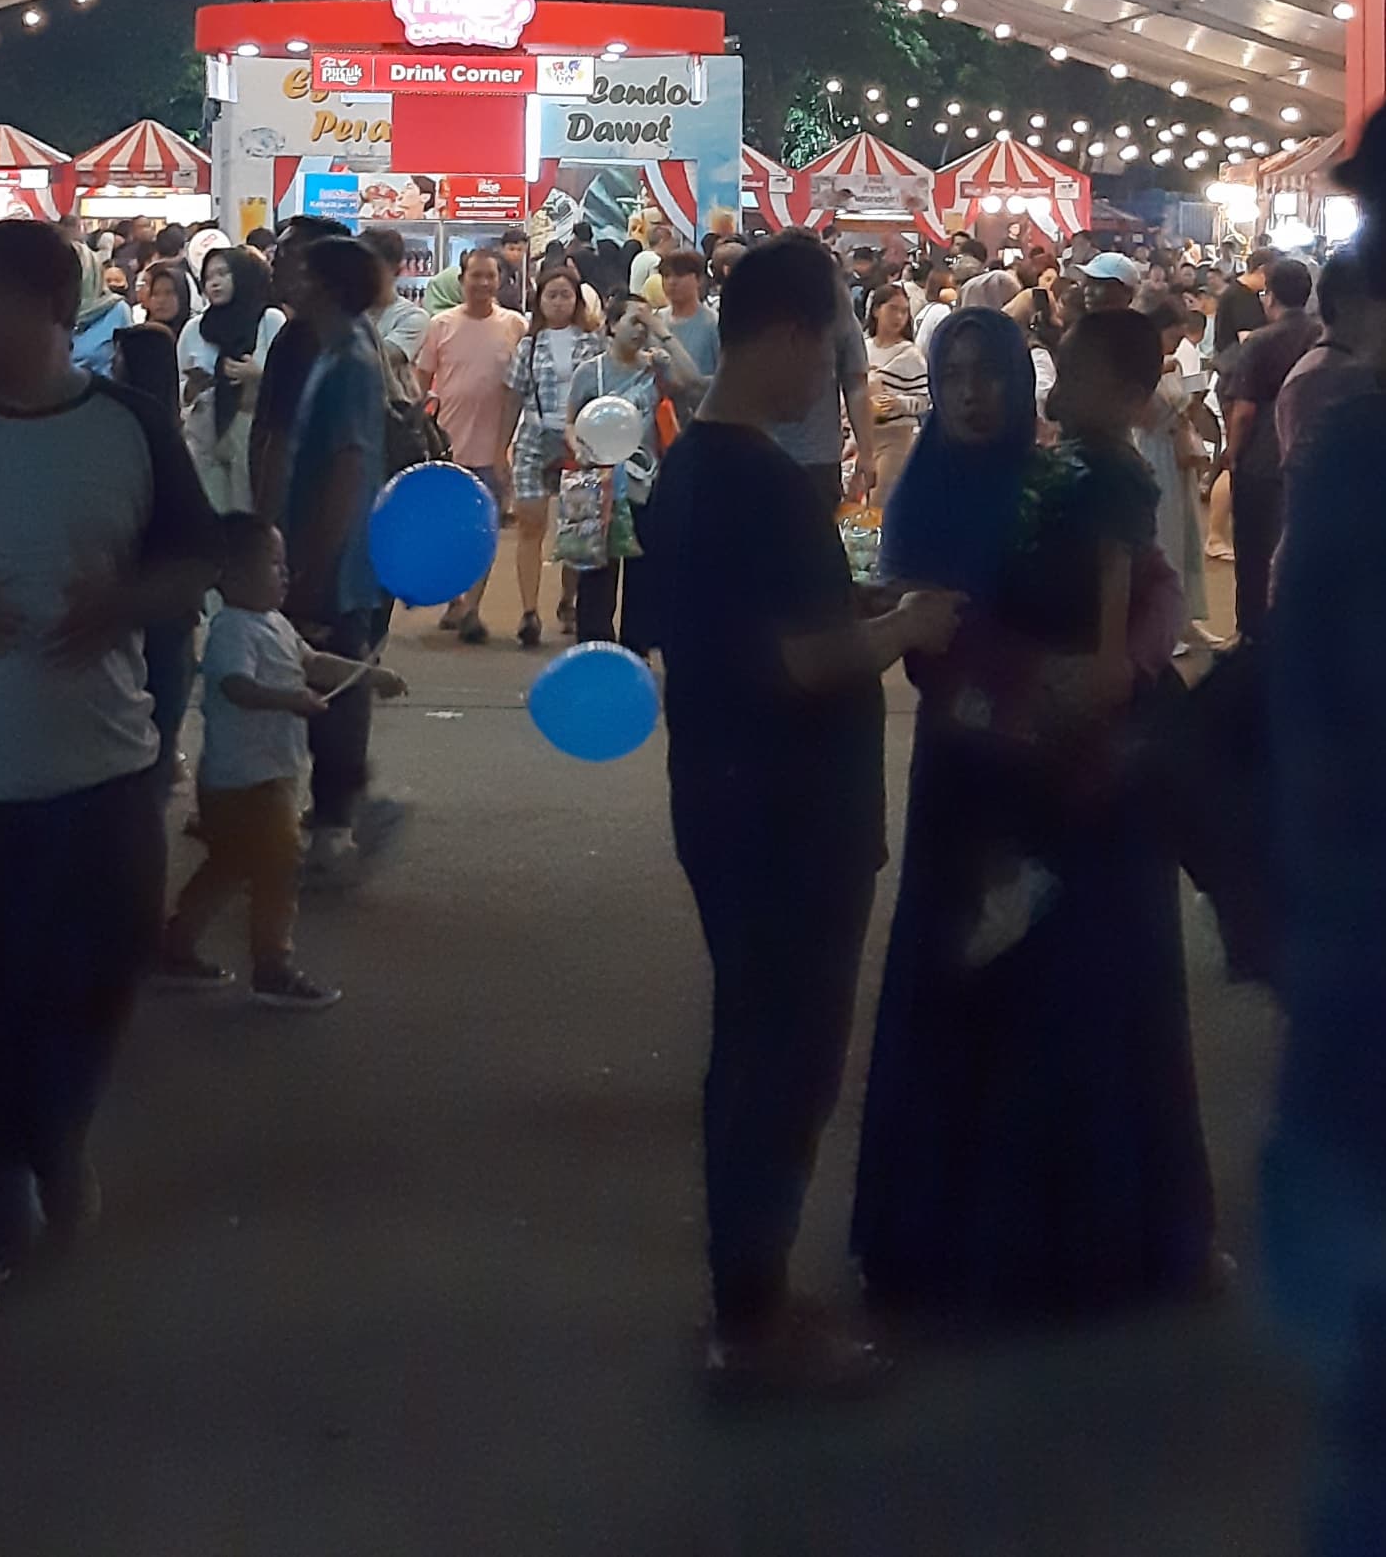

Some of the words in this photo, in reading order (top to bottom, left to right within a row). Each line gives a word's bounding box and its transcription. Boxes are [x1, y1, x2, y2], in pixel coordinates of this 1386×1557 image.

[390, 64, 447, 82] Drink
[451, 65, 524, 83] Corner
[567, 112, 672, 143] Dawet
